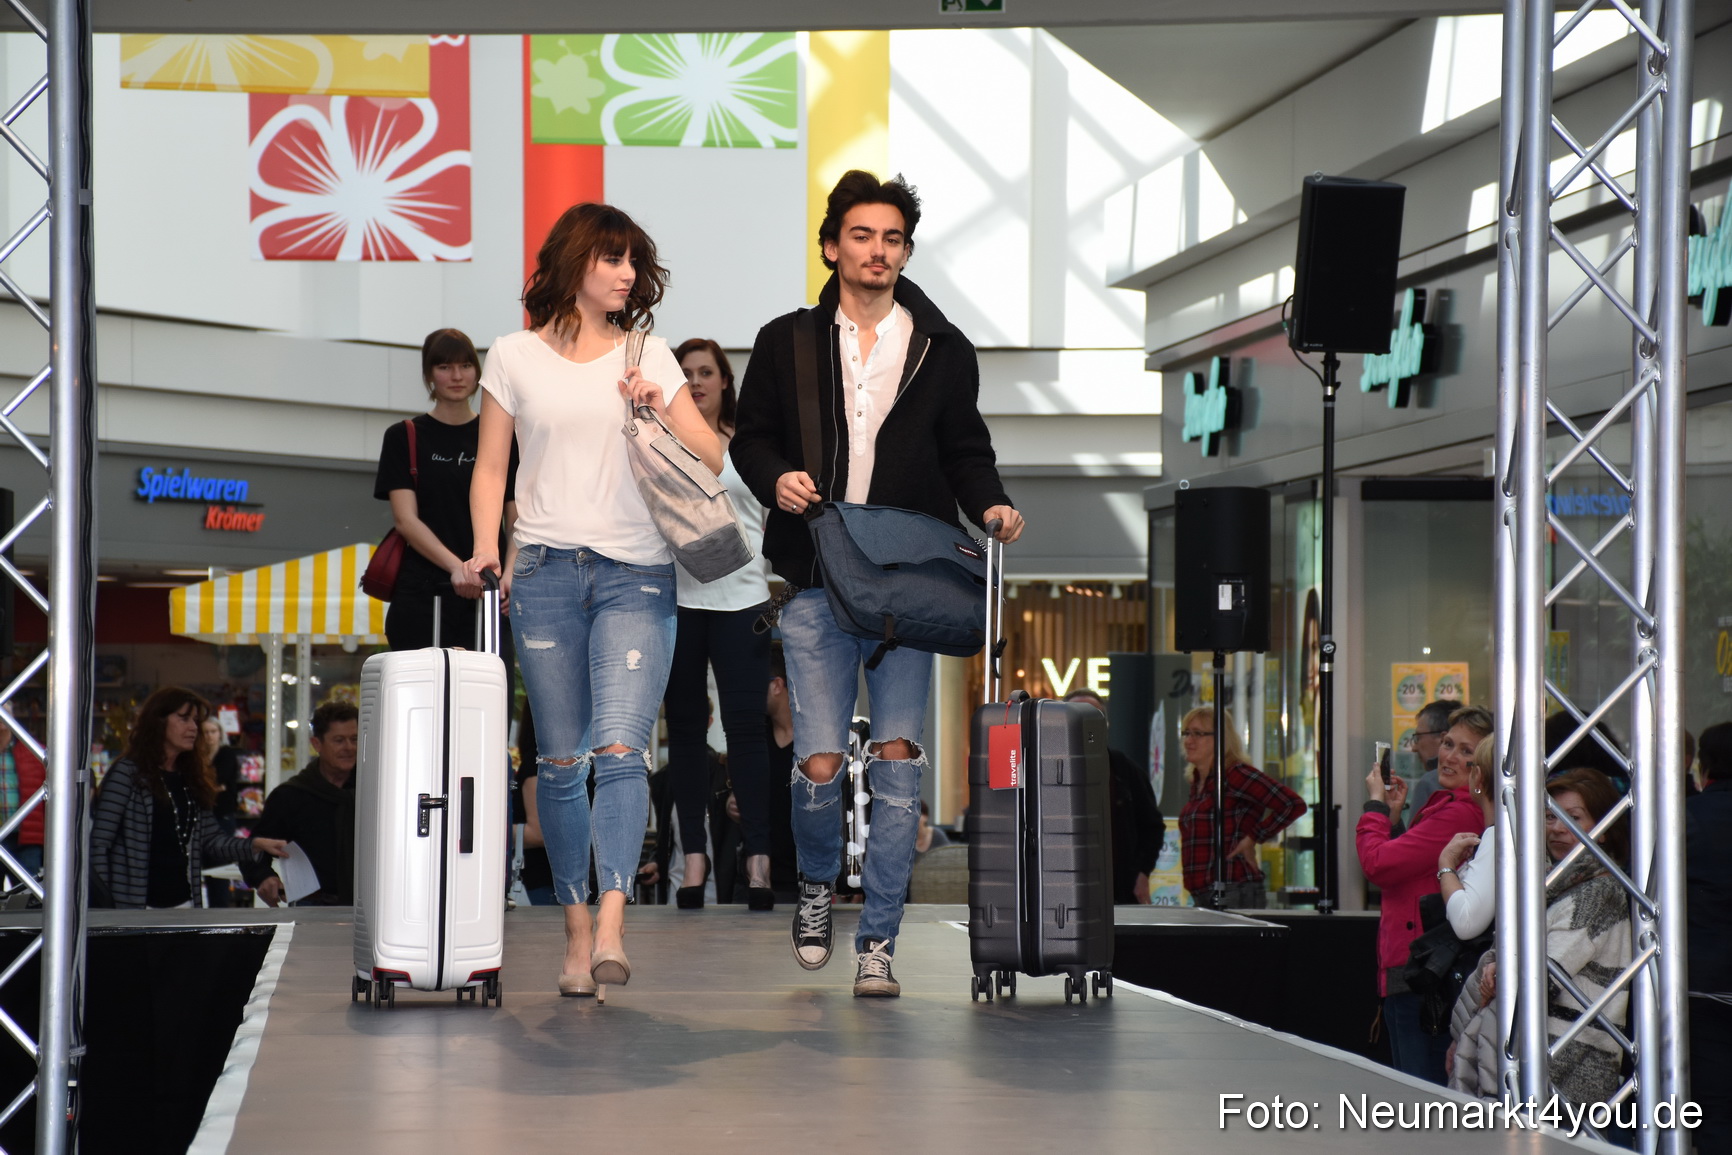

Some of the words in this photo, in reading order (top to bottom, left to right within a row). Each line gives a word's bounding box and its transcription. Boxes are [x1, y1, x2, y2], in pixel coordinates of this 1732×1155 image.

[136, 466, 249, 504] Spielwaren
[204, 505, 266, 533] Krömer
[1009, 749, 1017, 787] travelite
